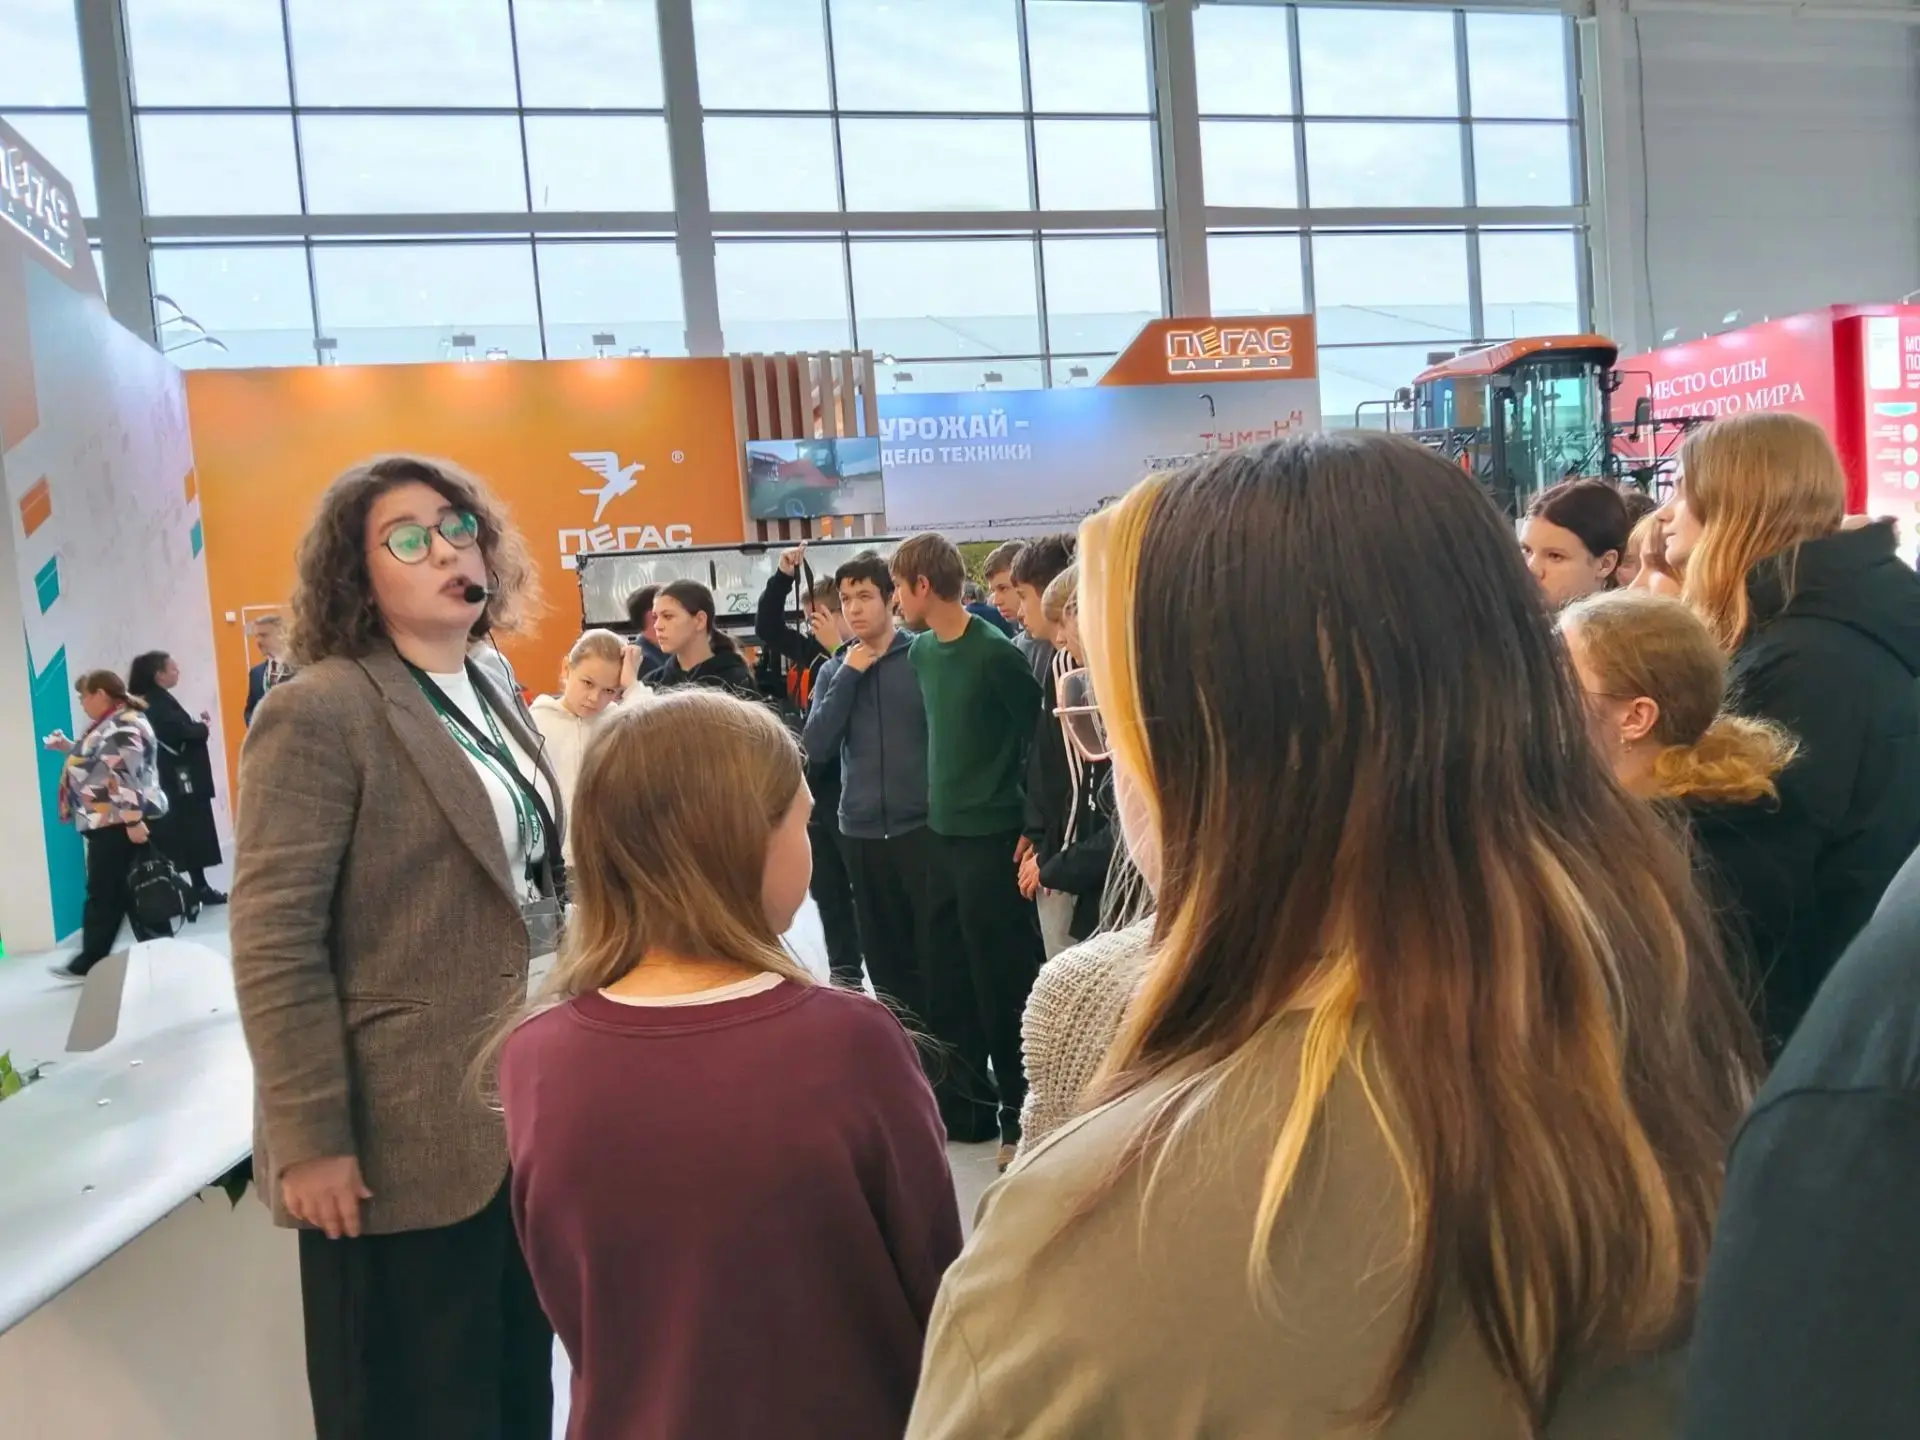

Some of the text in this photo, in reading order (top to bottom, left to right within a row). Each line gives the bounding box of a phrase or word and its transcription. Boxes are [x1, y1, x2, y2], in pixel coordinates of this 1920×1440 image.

[1167, 326, 1292, 358] ПЕГАС
[1186, 357, 1279, 370] АГРО
[1645, 357, 1767, 401] МЕСТО СИЛЫ
[1746, 381, 1805, 411] МИРА
[879, 408, 1009, 442] УРОЖАЙ
[881, 443, 1032, 468] ДЕЛО ТЕХНИКИ
[557, 523, 693, 554] ПЕГАС
